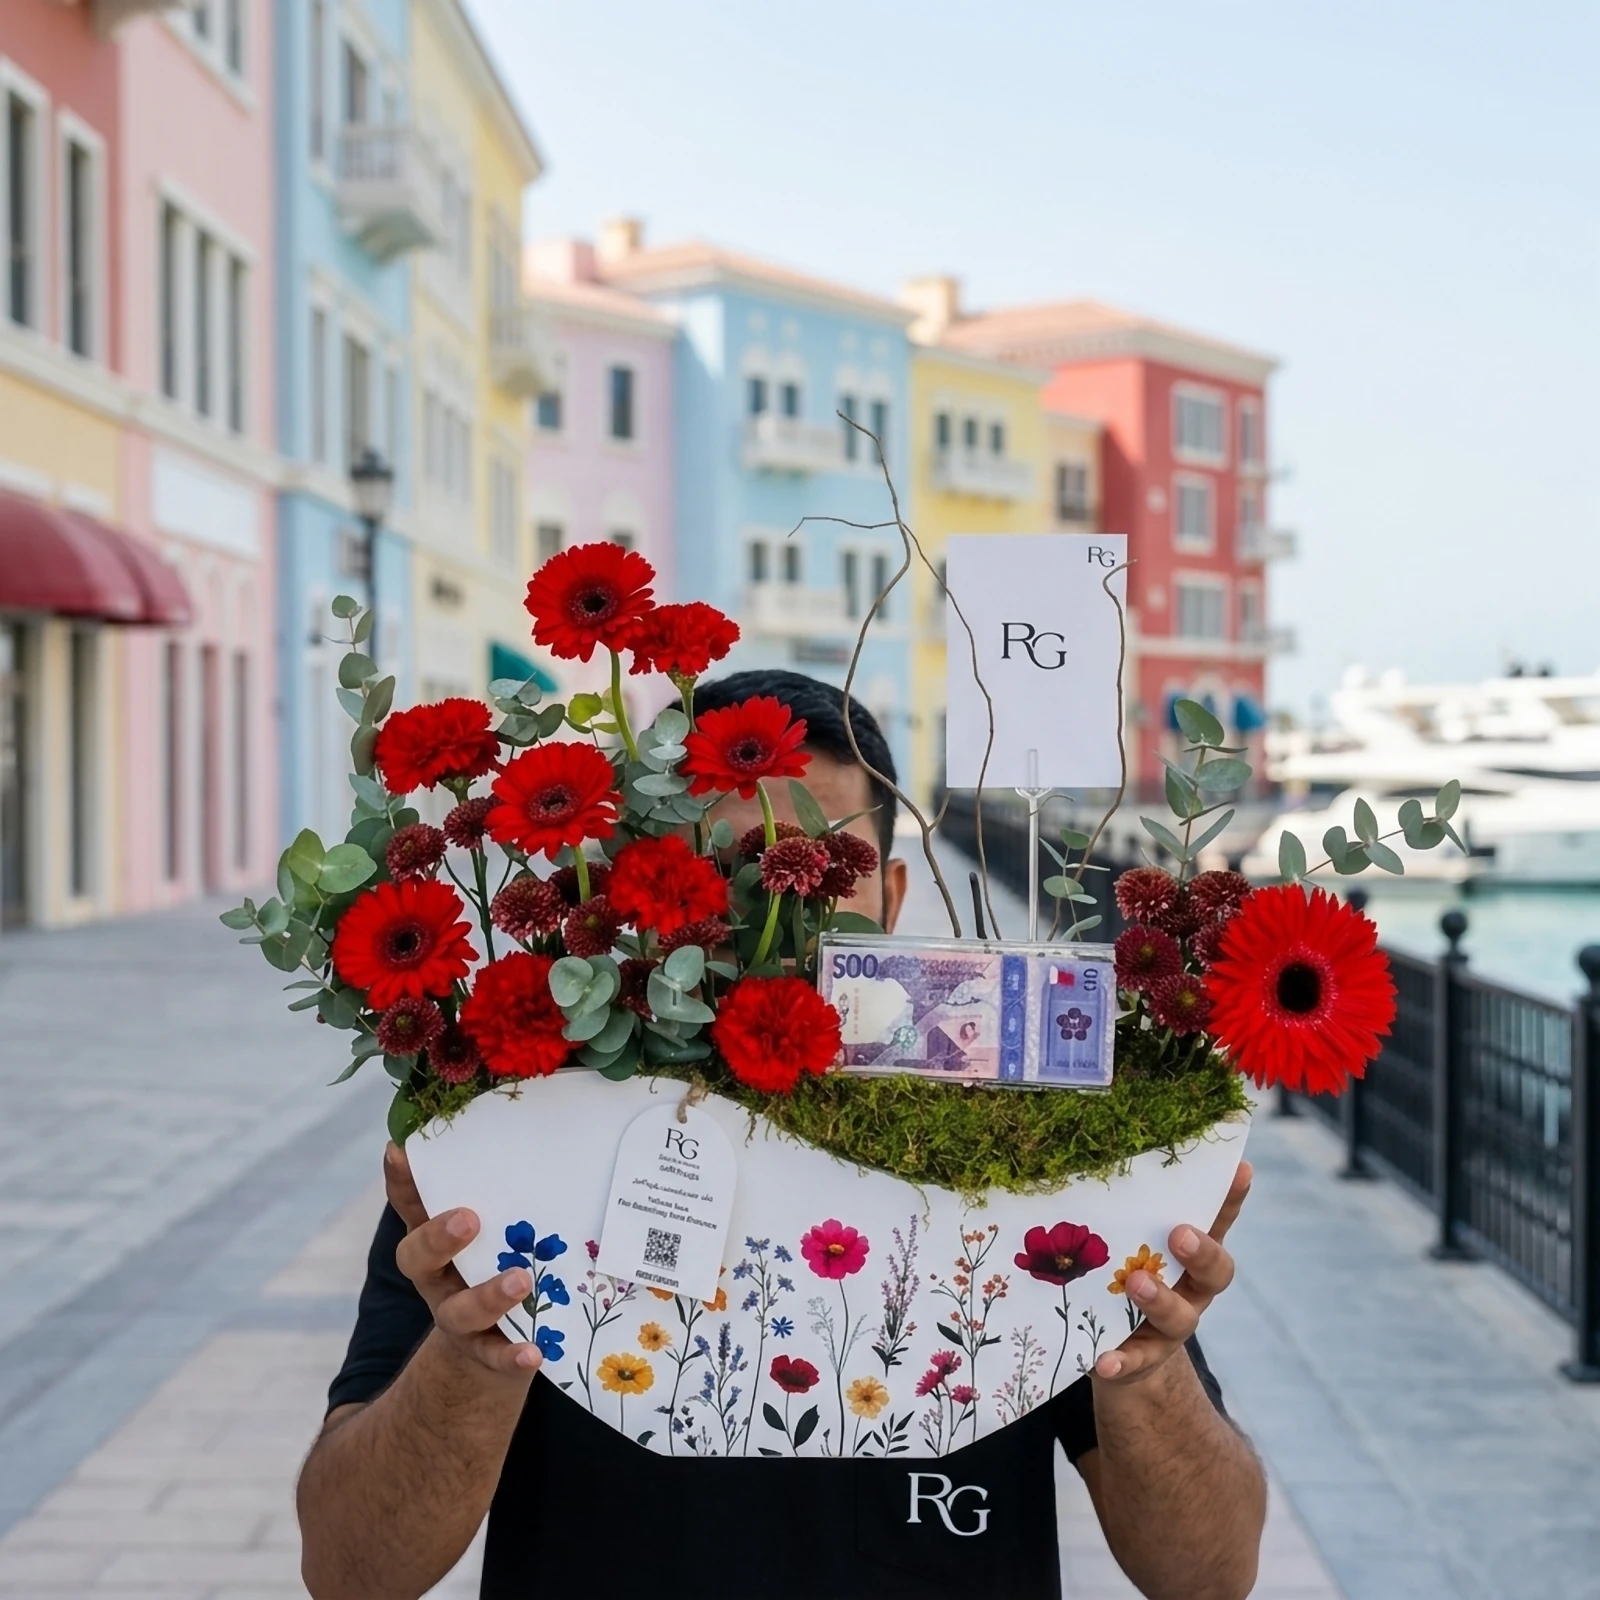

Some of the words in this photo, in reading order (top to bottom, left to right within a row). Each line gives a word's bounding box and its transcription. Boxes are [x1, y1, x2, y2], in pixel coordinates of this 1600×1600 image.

[1087, 546, 1115, 568] RG
[1001, 622, 1067, 670] RG
[665, 1127, 700, 1160] RG
[906, 1472, 991, 1536] RG
